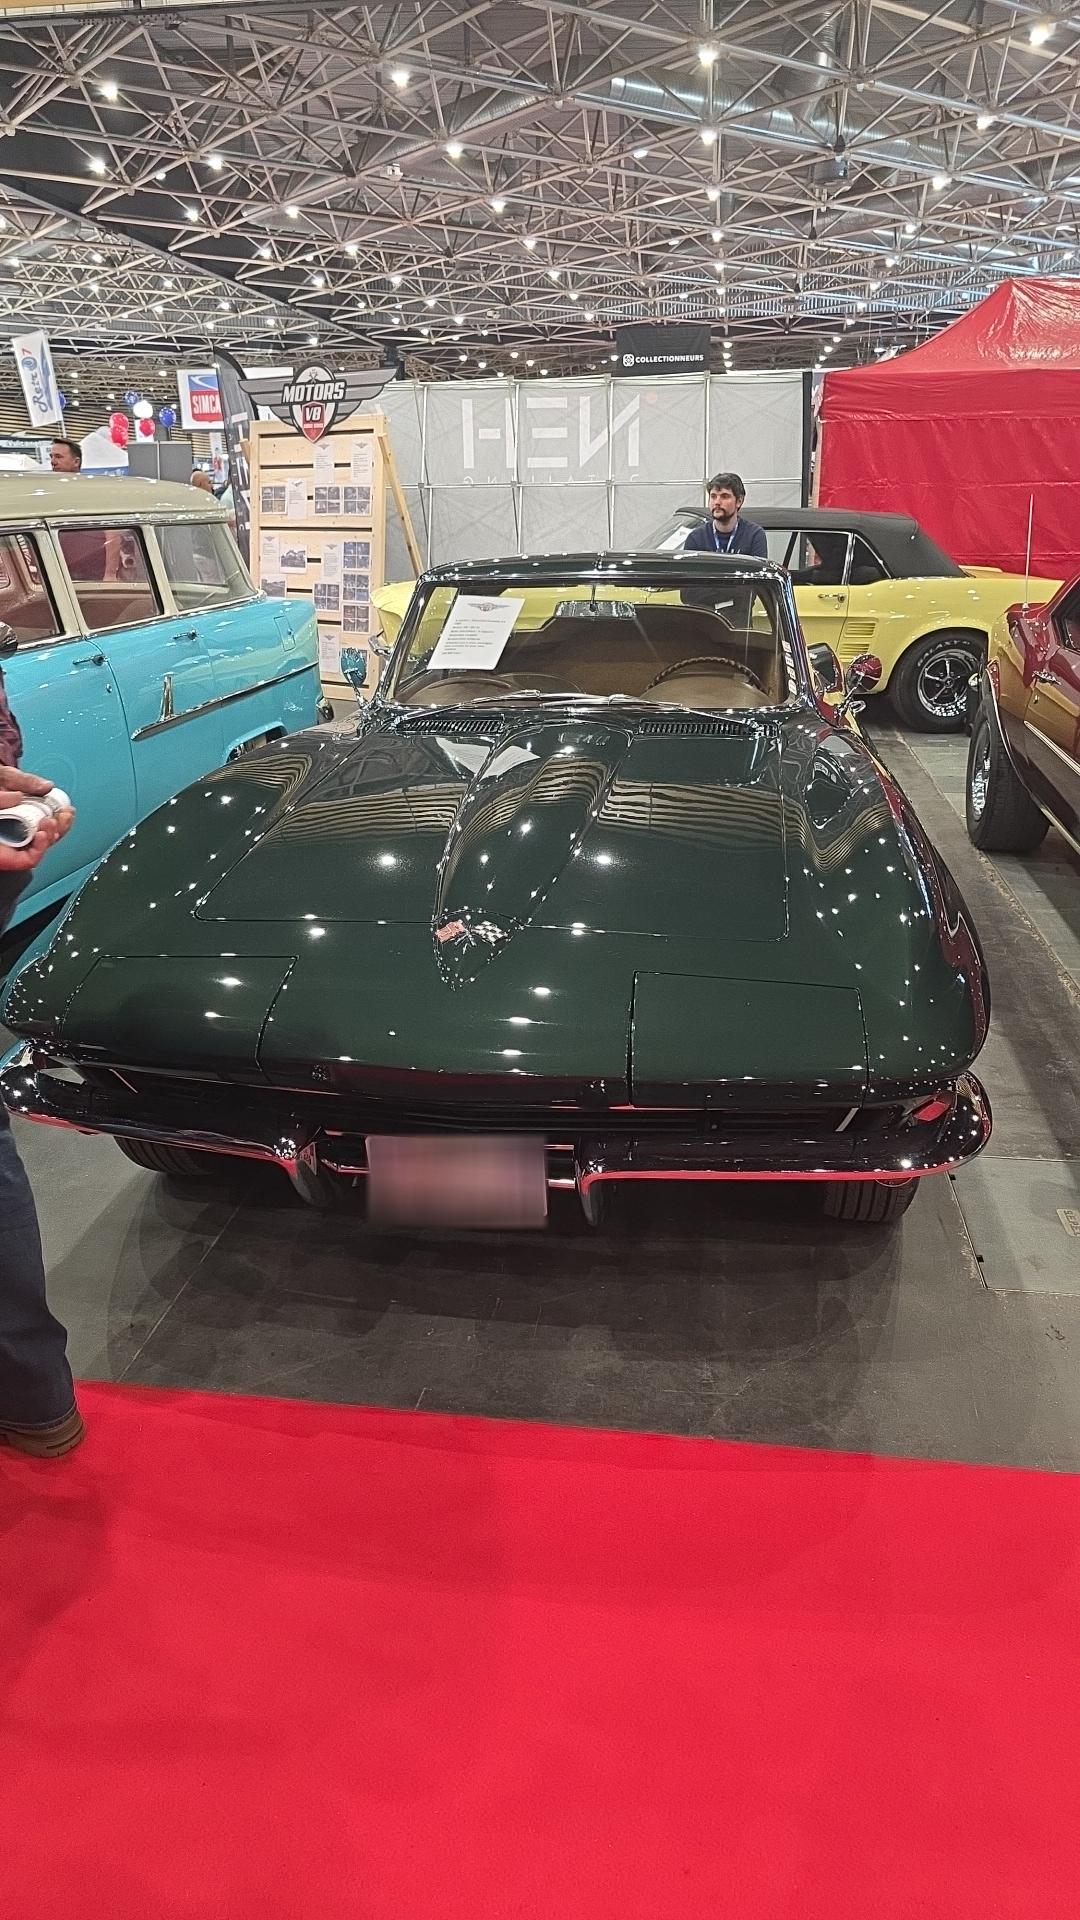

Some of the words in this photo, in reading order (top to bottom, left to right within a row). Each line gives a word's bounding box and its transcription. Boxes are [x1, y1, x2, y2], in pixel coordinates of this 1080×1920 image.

[635, 354, 704, 364] COLLECTIONNEURS
[283, 381, 346, 403] MOTORS
[192, 394, 222, 414] SIMCA
